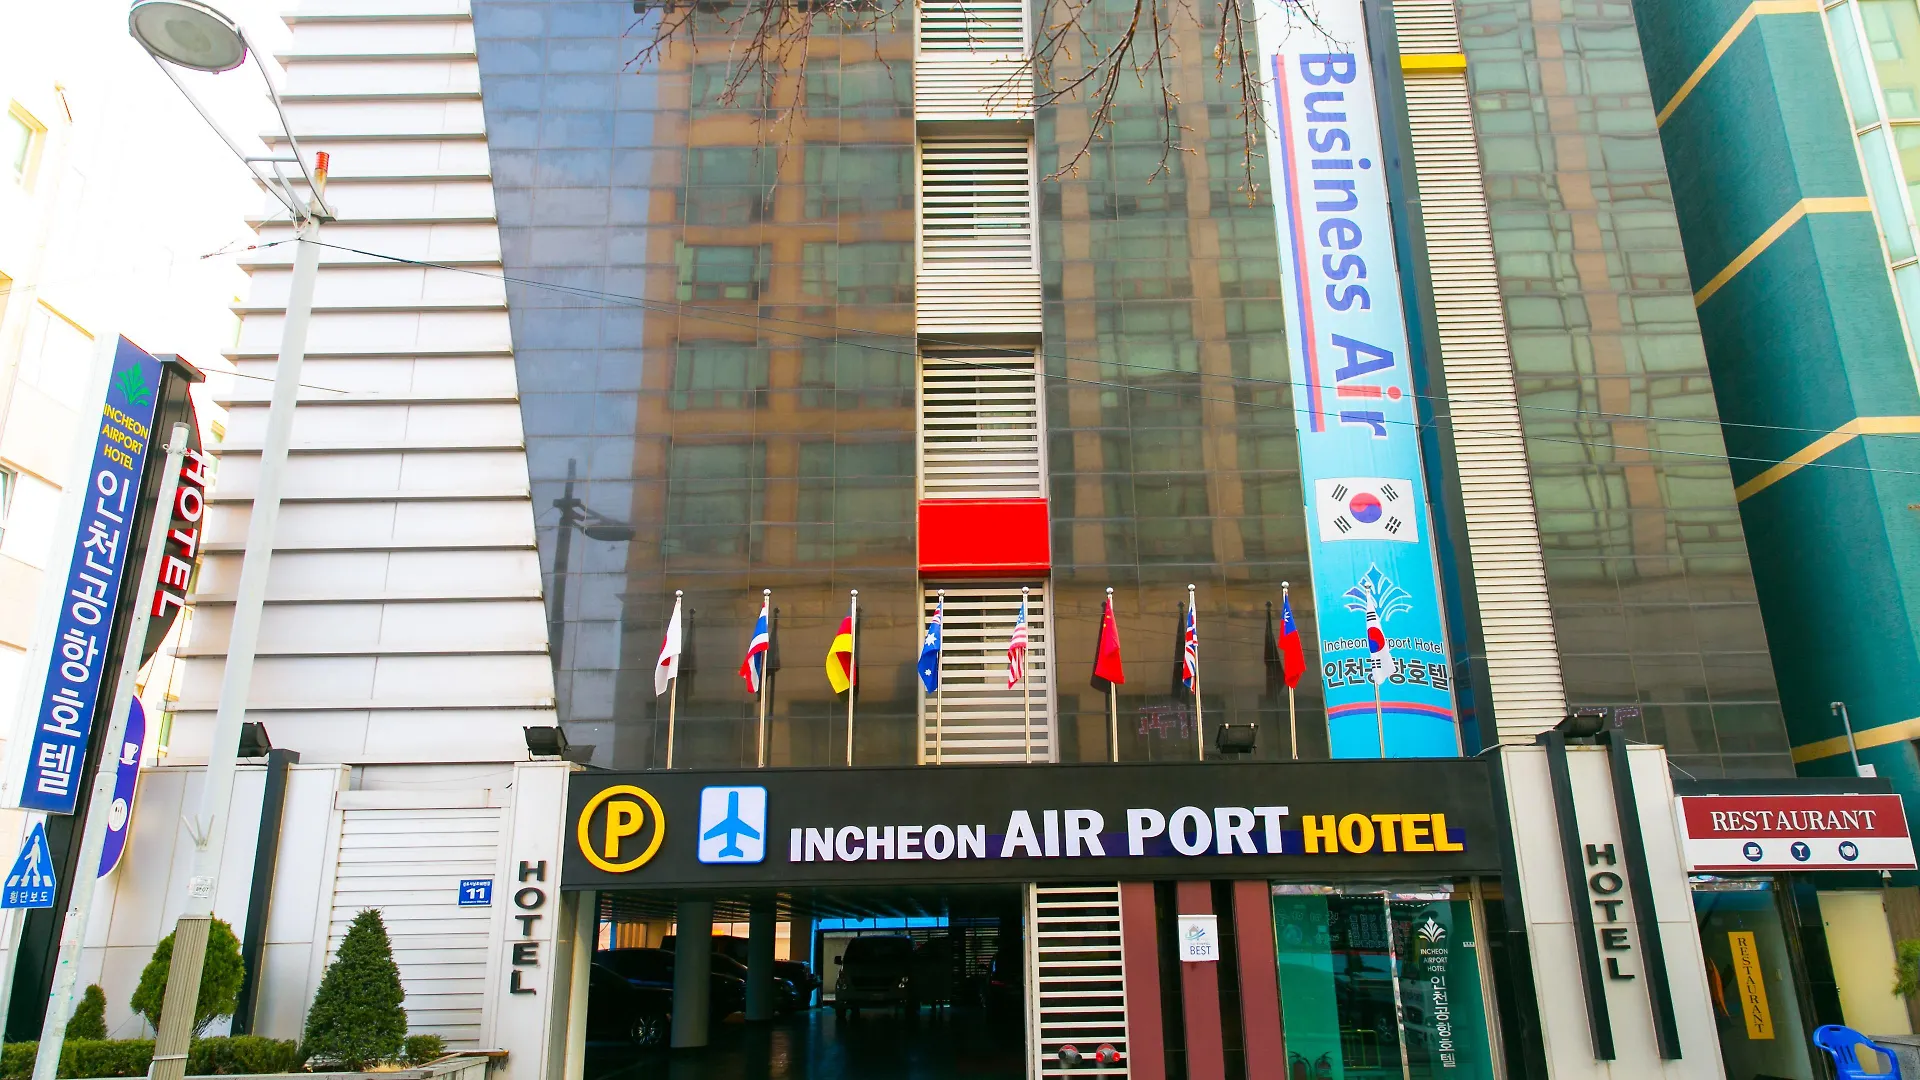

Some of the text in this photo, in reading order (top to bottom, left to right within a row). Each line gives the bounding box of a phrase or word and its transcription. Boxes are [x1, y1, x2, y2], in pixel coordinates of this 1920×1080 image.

[1300, 53, 1402, 440] Business Air
[102, 424, 143, 455] AIRPORT
[104, 404, 149, 439] INCHEON
[104, 444, 133, 470] HOTEL
[151, 448, 209, 617] HOTEL
[37, 469, 130, 796] 인천공항호텔
[1324, 638, 1368, 652] Incheon
[1414, 639, 1444, 654] Hotel
[604, 801, 644, 858] P
[790, 806, 1464, 862] INCHEON AIR PORT HOTEL
[1710, 810, 1877, 831] RESTAURANT
[9, 890, 48, 904] 횡단보도
[466, 887, 485, 899] 11
[1585, 843, 1635, 980] HOTEL
[510, 860, 547, 996] HOTEL
[1190, 945, 1211, 955] BEST
[1738, 937, 1764, 1033] RESTAURANT
[1430, 975, 1456, 1068] 인천공항호텔
